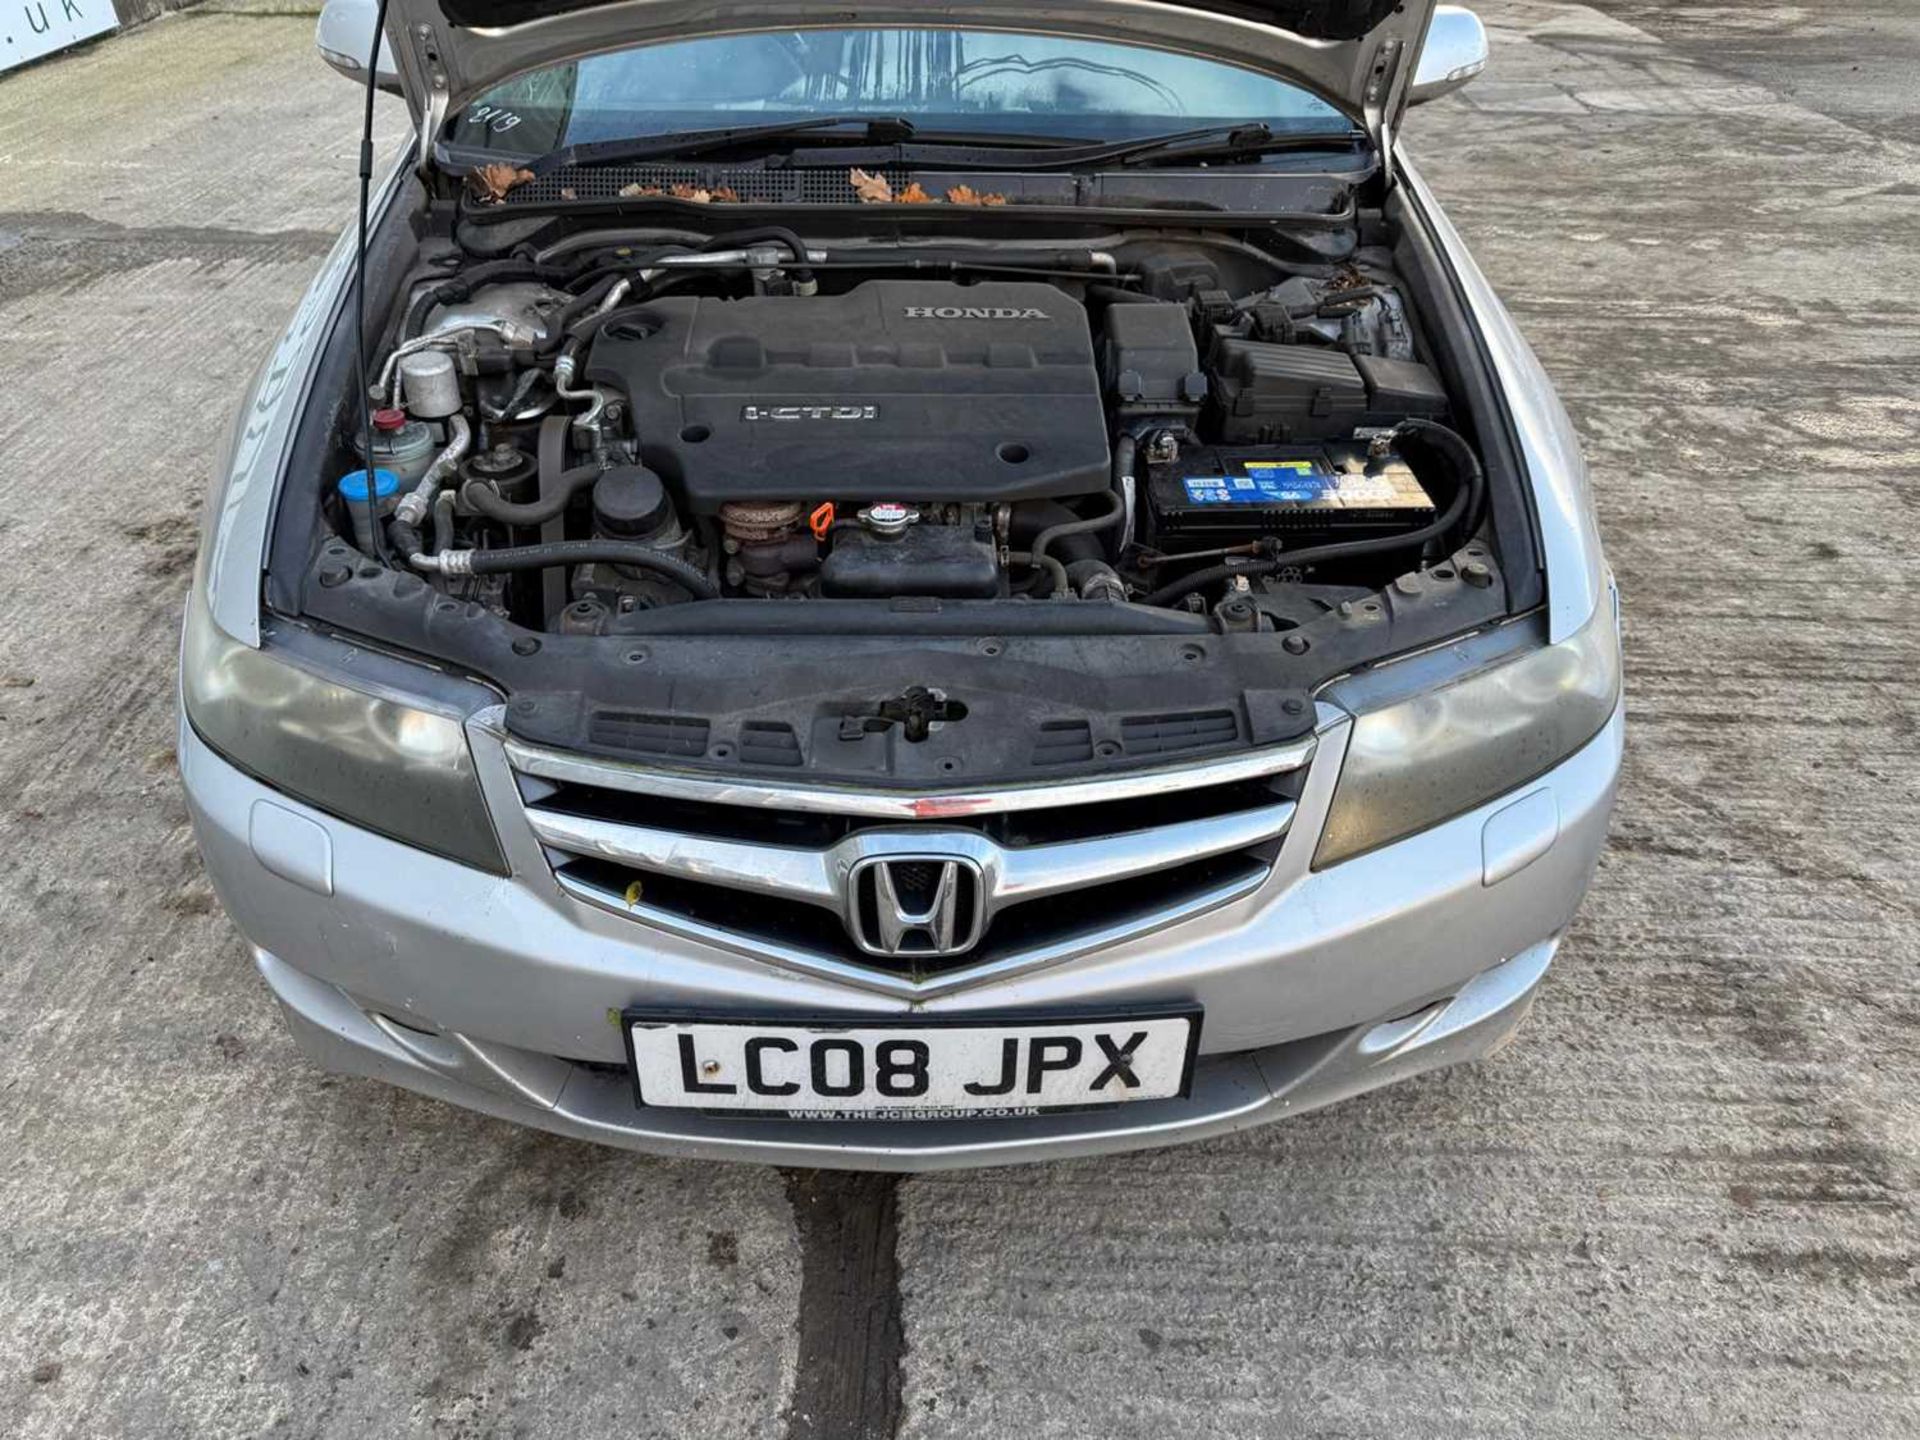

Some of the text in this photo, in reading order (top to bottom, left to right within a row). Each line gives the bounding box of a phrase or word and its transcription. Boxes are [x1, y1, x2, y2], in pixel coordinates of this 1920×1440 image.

[904, 307, 1049, 319] HONDA
[678, 1031, 1147, 1098] LC08 JPX
